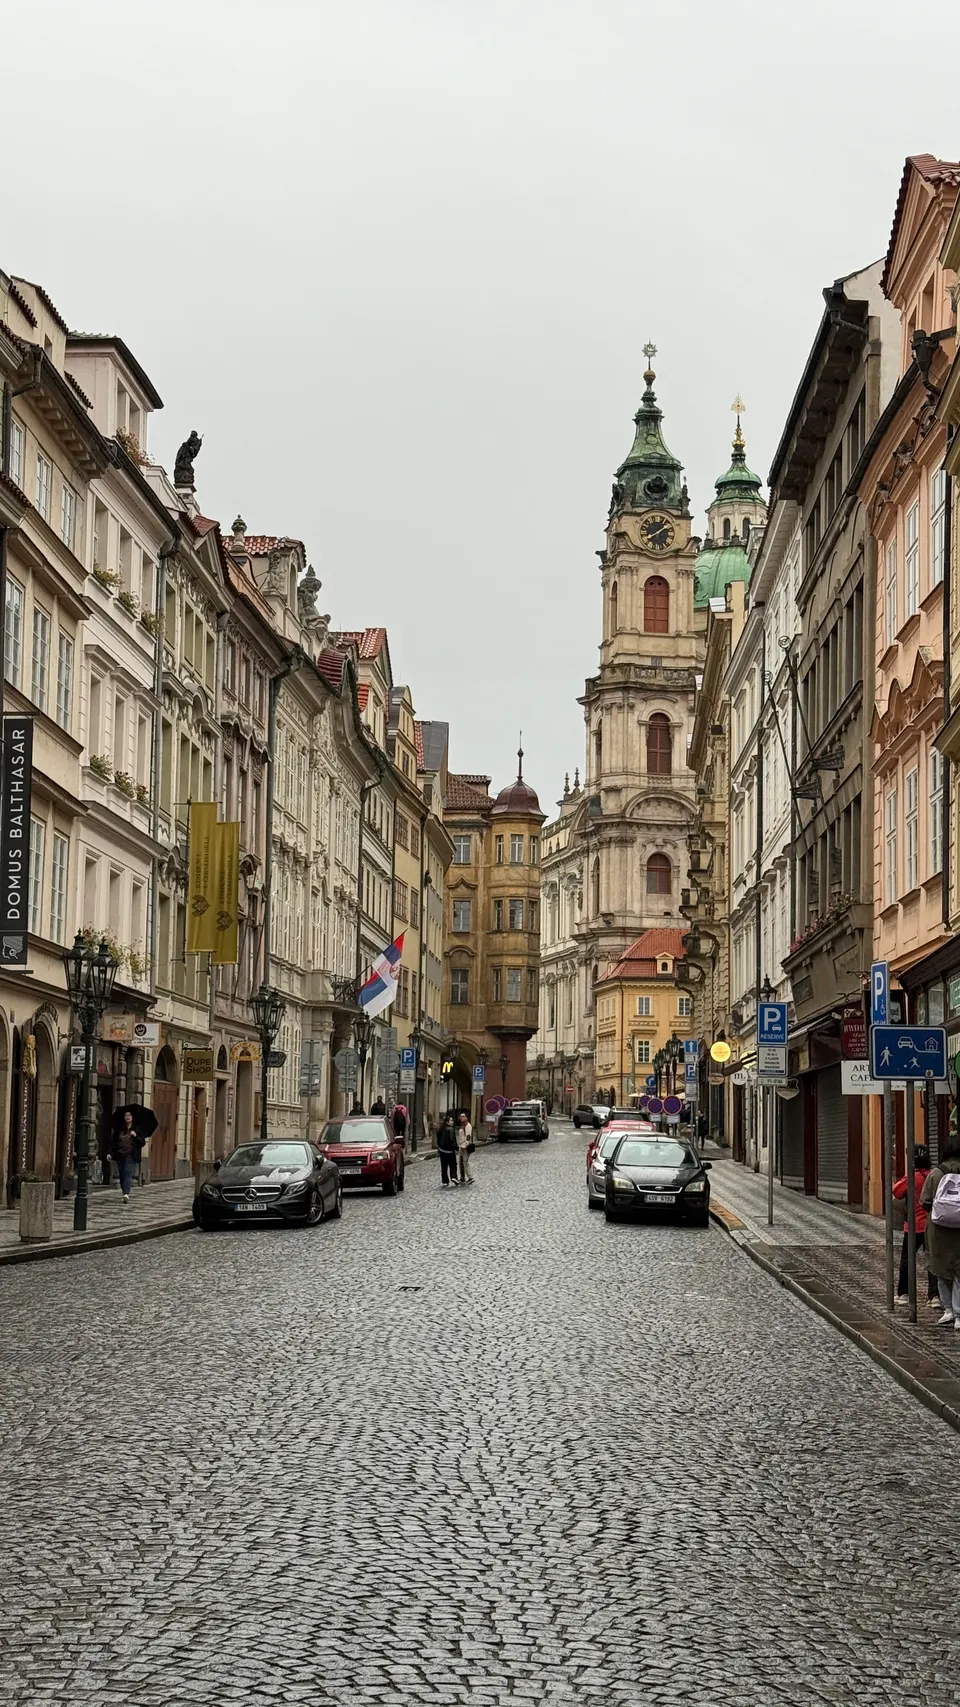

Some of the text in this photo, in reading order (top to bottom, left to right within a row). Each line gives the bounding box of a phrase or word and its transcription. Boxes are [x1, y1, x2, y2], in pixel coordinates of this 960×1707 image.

[7, 729, 25, 920] DOMUS BALTHASAR
[874, 971, 884, 1011] P
[764, 1008, 781, 1031] P
[186, 1057, 211, 1066] DUPE
[403, 1050, 413, 1062] P
[186, 1066, 211, 1074] SHOP
[475, 1067, 482, 1076] P
[687, 1065, 695, 1077] P
[21, 1079, 29, 1169] MANUFAKTURA
